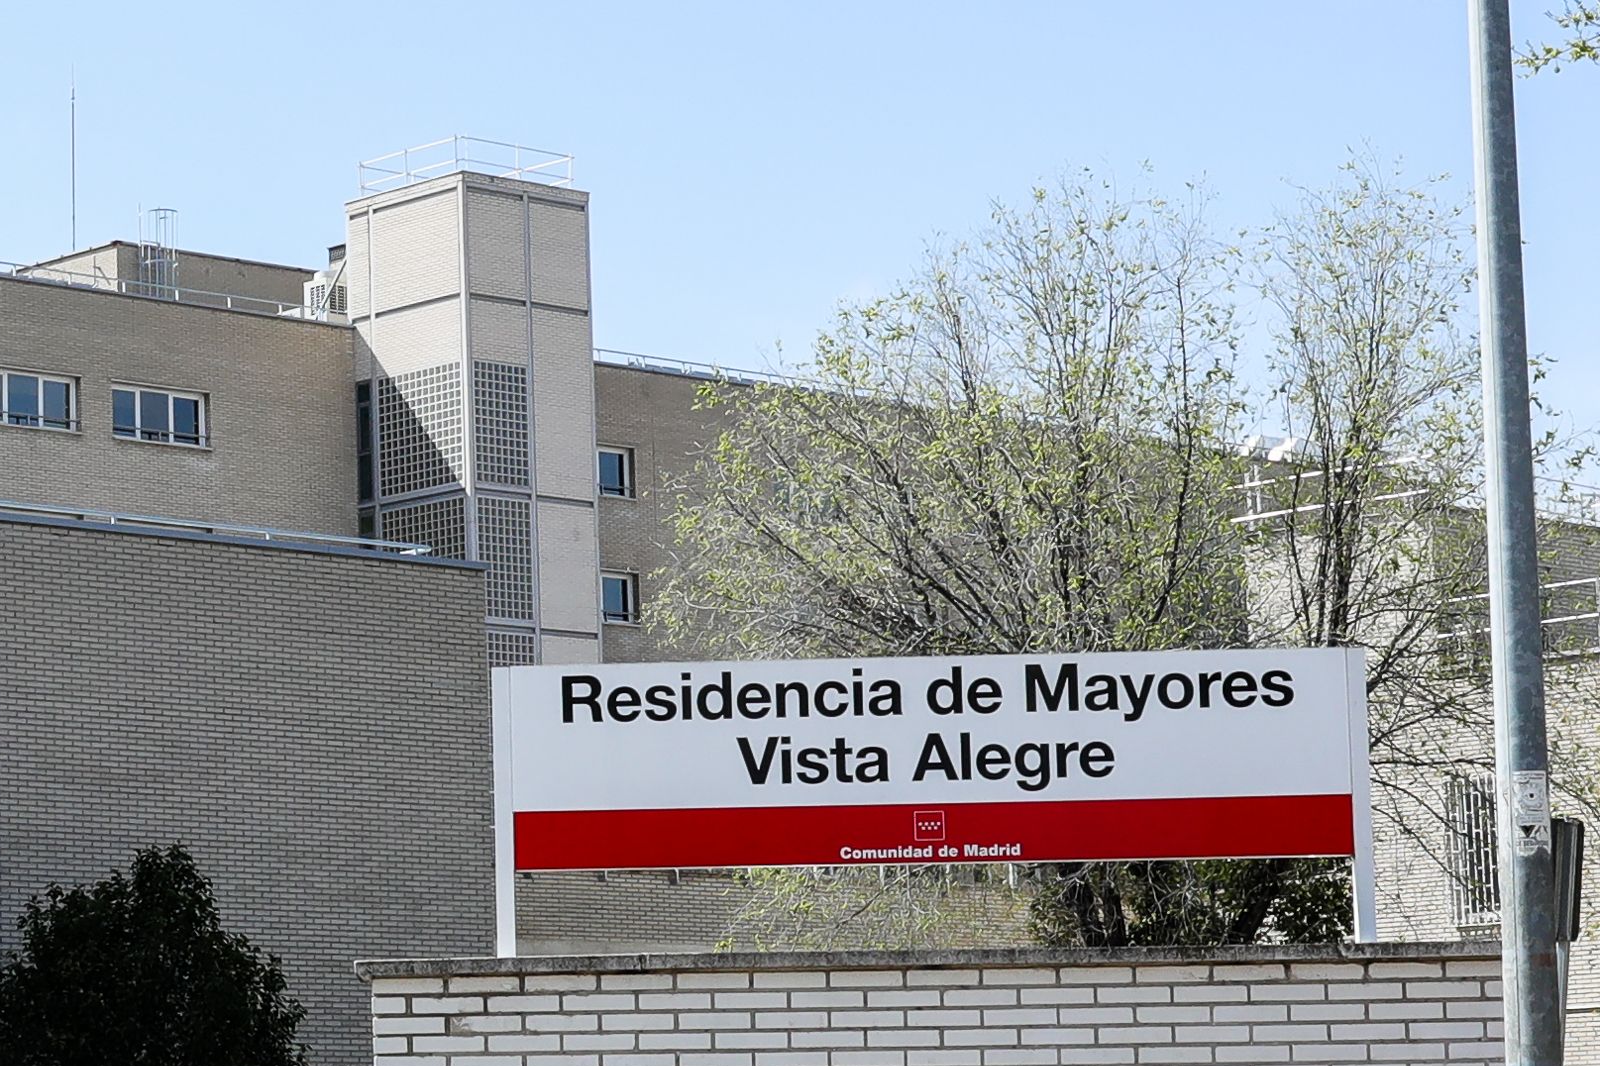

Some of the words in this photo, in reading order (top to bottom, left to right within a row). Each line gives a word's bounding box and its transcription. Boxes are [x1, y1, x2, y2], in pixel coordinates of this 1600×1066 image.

[561, 666, 903, 724] Residencia
[926, 665, 1003, 716] de
[1024, 662, 1295, 722] Mayores
[735, 735, 890, 785] Vista
[911, 731, 1115, 792] Alegre
[840, 846, 933, 860] Comunidad
[937, 844, 959, 858] de
[963, 843, 1021, 857] Madrid
